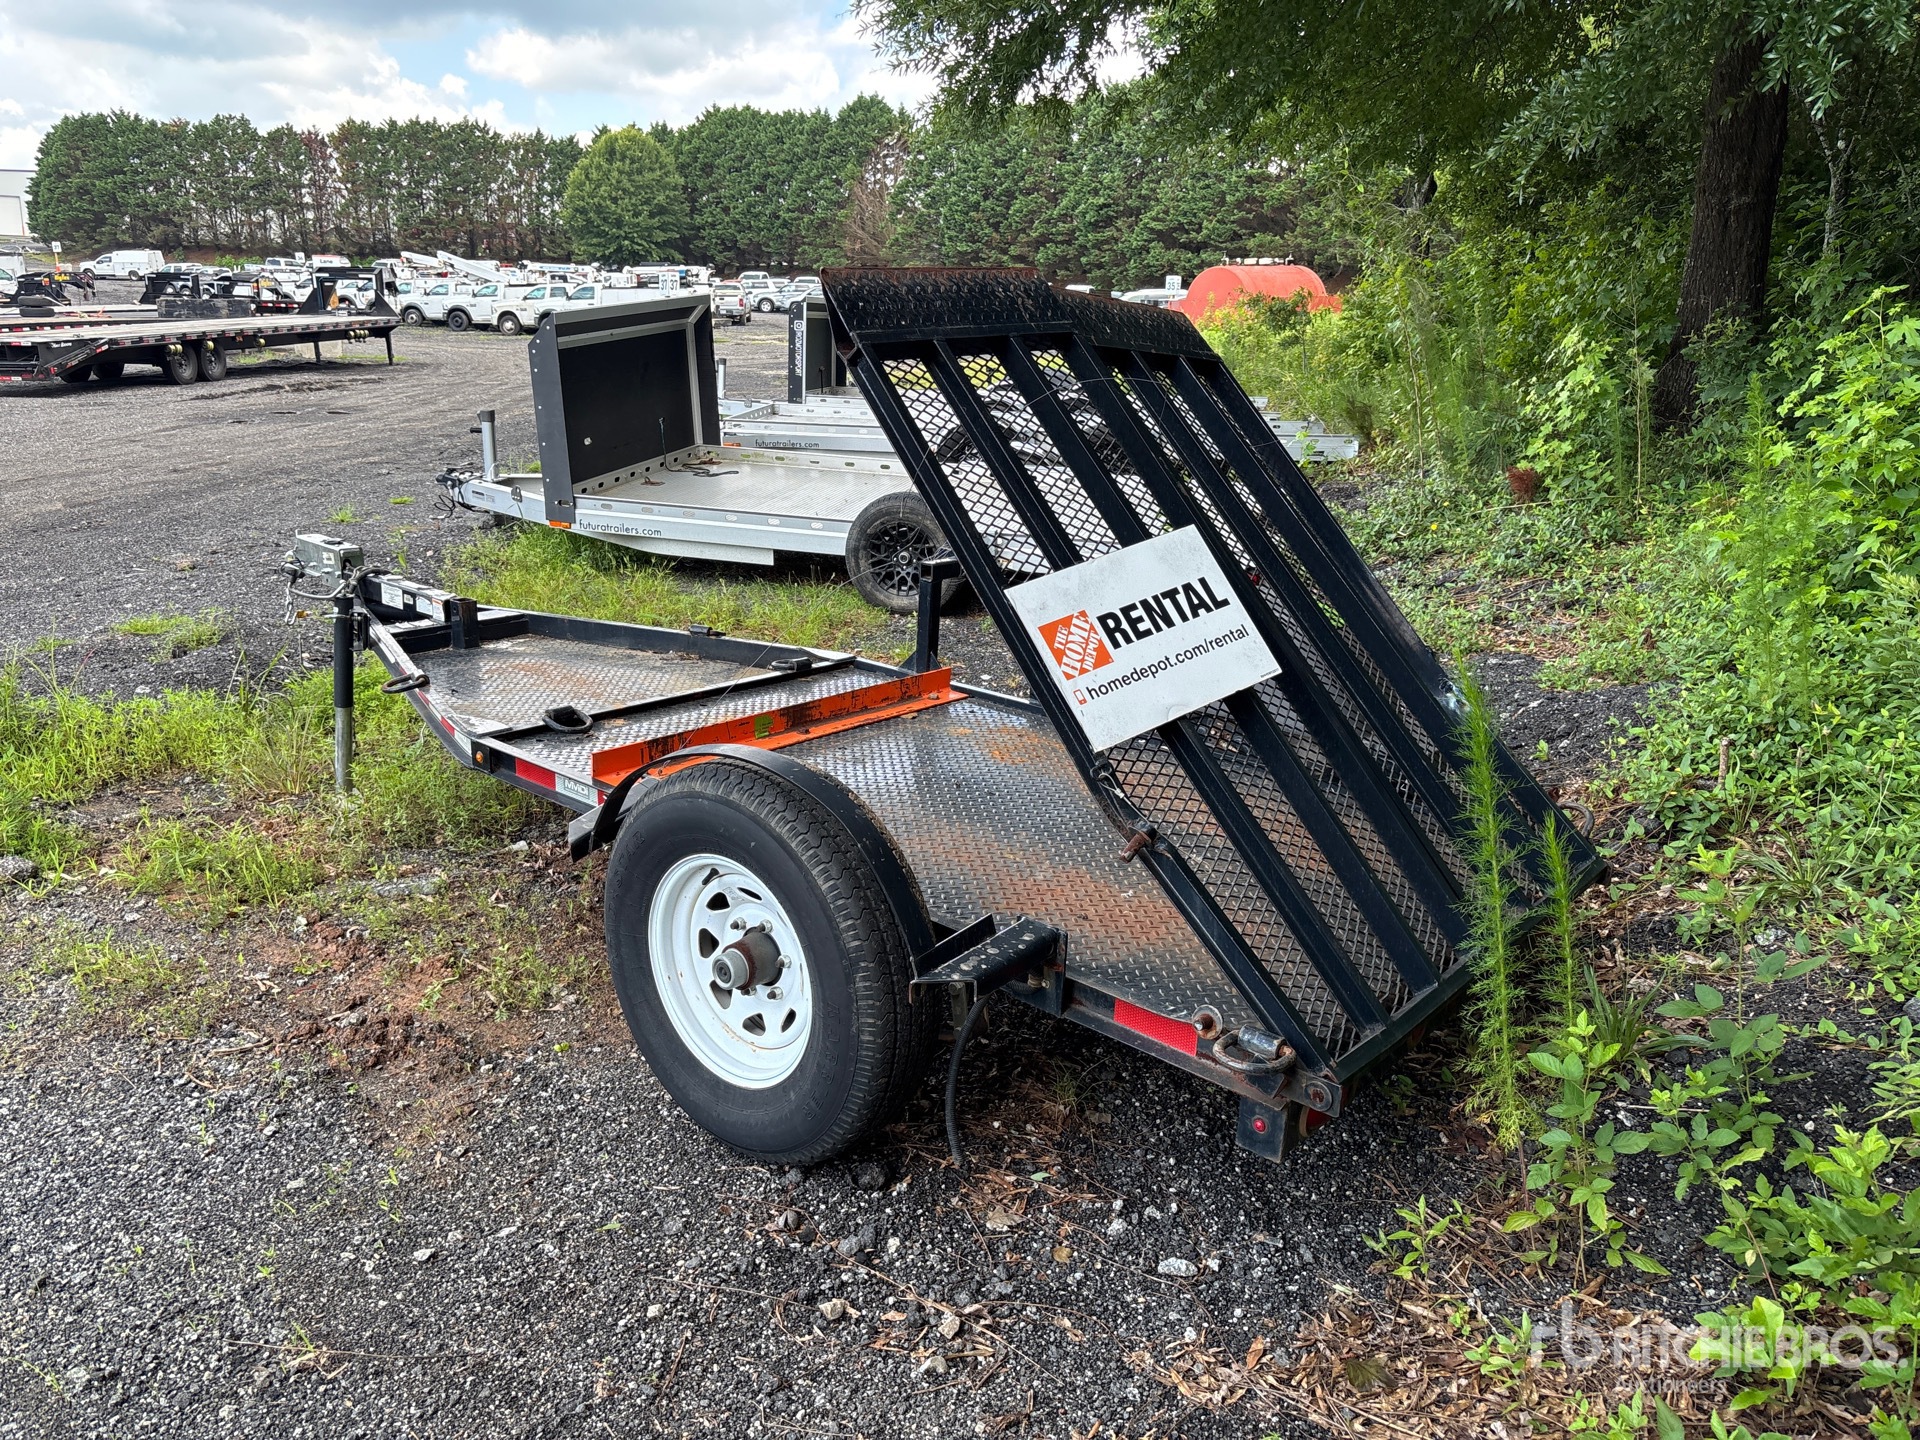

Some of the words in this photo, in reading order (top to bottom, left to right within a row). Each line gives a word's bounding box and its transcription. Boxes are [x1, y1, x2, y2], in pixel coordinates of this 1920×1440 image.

[661, 279, 667, 290] 37
[670, 279, 678, 290] 37
[1167, 282, 1176, 290] 35
[755, 439, 820, 448] futuratrailers.com
[580, 519, 661, 536] futuratrailers.com
[1096, 576, 1231, 650] RENTAL
[1053, 625, 1068, 650] THE
[1061, 613, 1091, 677] HOME
[1083, 630, 1102, 671] DEPOT
[1086, 624, 1250, 700] homedepot.com/rental
